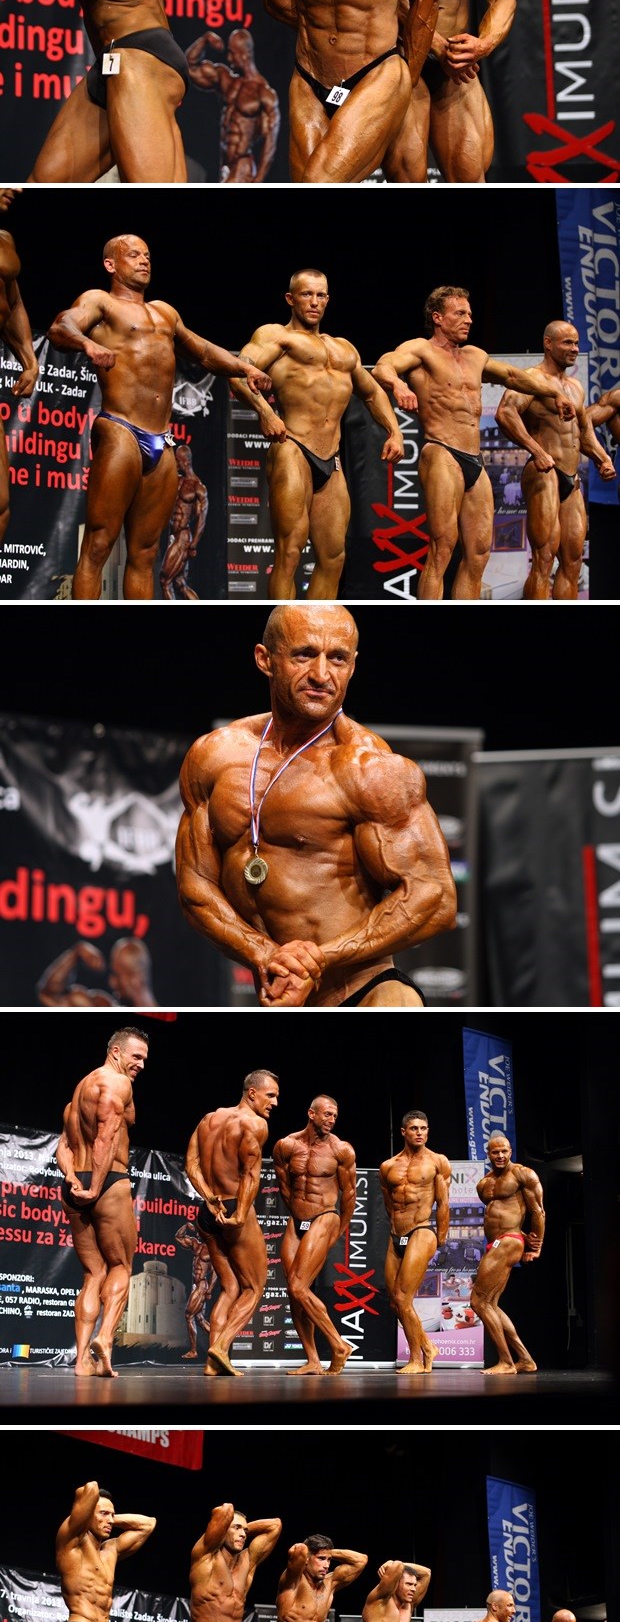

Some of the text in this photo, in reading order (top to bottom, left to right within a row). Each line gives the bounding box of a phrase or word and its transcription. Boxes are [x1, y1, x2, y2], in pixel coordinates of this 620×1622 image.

[109, 57, 115, 72] 7
[15, 63, 22, 97] i
[331, 90, 344, 104] 98
[47, 364, 98, 383] Zadar, Širo
[61, 386, 87, 399] Zadar
[179, 396, 197, 407] IFBB
[228, 458, 260, 467] WEIDER
[35, 463, 40, 487] i
[4, 543, 47, 557] MITROVIĆ,
[227, 563, 258, 571] WEIDER
[0, 866, 149, 939] dingu,
[13, 1149, 36, 1161] 2013.
[130, 1167, 171, 1182] Široka ulica
[1, 1181, 62, 1202] prvenst
[302, 1222, 310, 1230] 59
[36, 1233, 54, 1246] za
[26, 1286, 59, 1296] MARASKA,
[5, 1296, 67, 1307] 057 RADIO, restoran
[439, 1347, 475, 1356] 006 333
[11, 1592, 39, 1606] travnja
